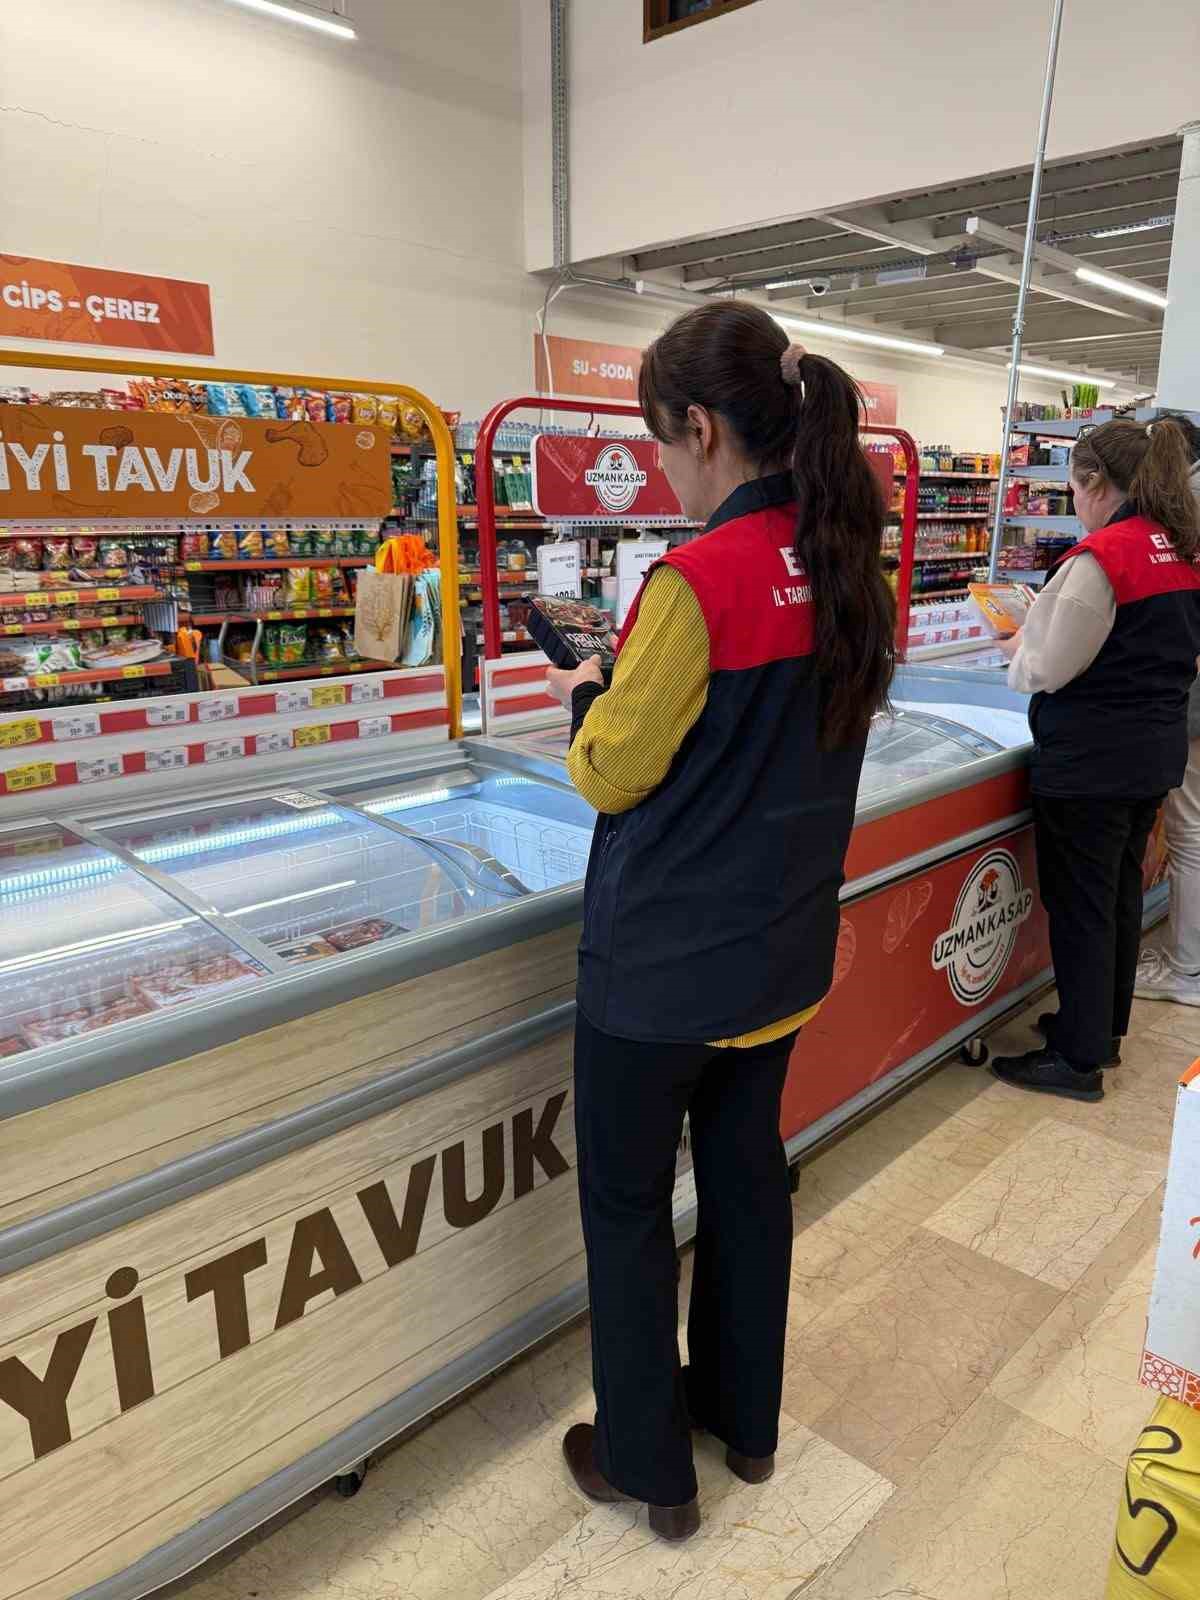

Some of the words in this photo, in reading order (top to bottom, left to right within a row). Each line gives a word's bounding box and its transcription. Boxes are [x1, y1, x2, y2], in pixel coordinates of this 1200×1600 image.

[2, 280, 63, 312] CİPS
[85, 295, 160, 323] ÇEREZ
[572, 359, 590, 375] SU
[599, 363, 634, 382] SODA
[82, 446, 256, 493] TAVUK
[185, 1089, 571, 1361] TAVUK
